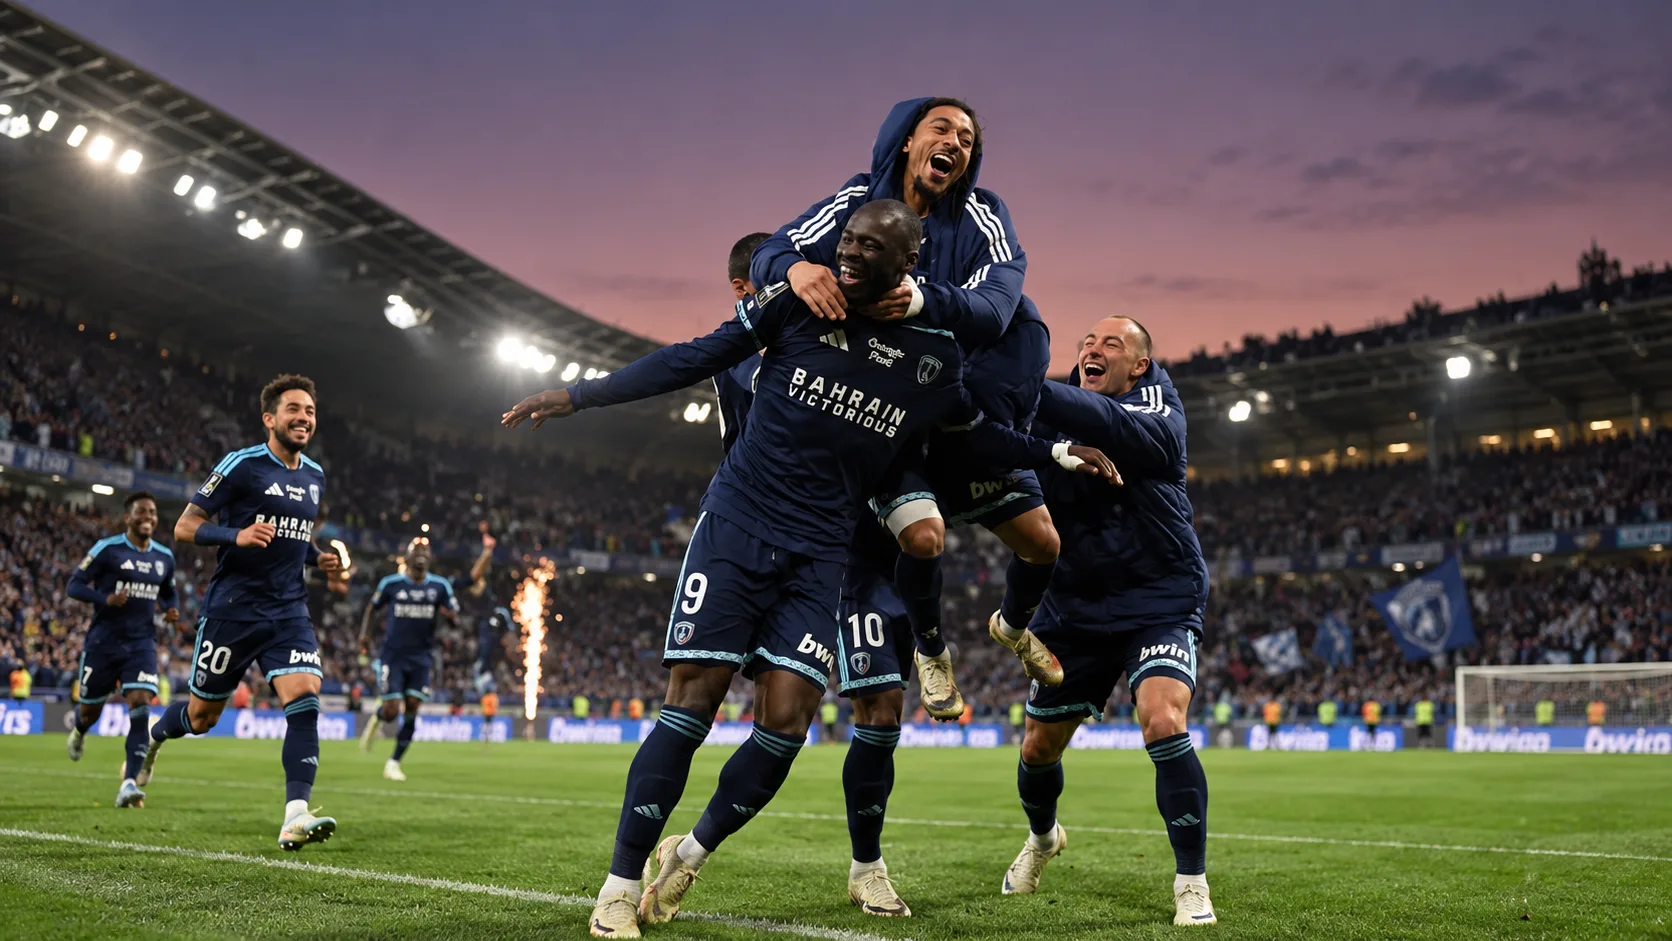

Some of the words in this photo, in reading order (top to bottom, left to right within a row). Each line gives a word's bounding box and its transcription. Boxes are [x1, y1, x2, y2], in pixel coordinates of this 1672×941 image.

[788, 383, 898, 438] VICTORIOUS
[791, 367, 907, 427] BAHRAIN
[681, 572, 708, 615] 9
[847, 612, 885, 648] 10
[197, 640, 232, 675] 20
[796, 632, 836, 673] bwi
[1138, 643, 1190, 664] bwin
[82, 665, 93, 685] 7
